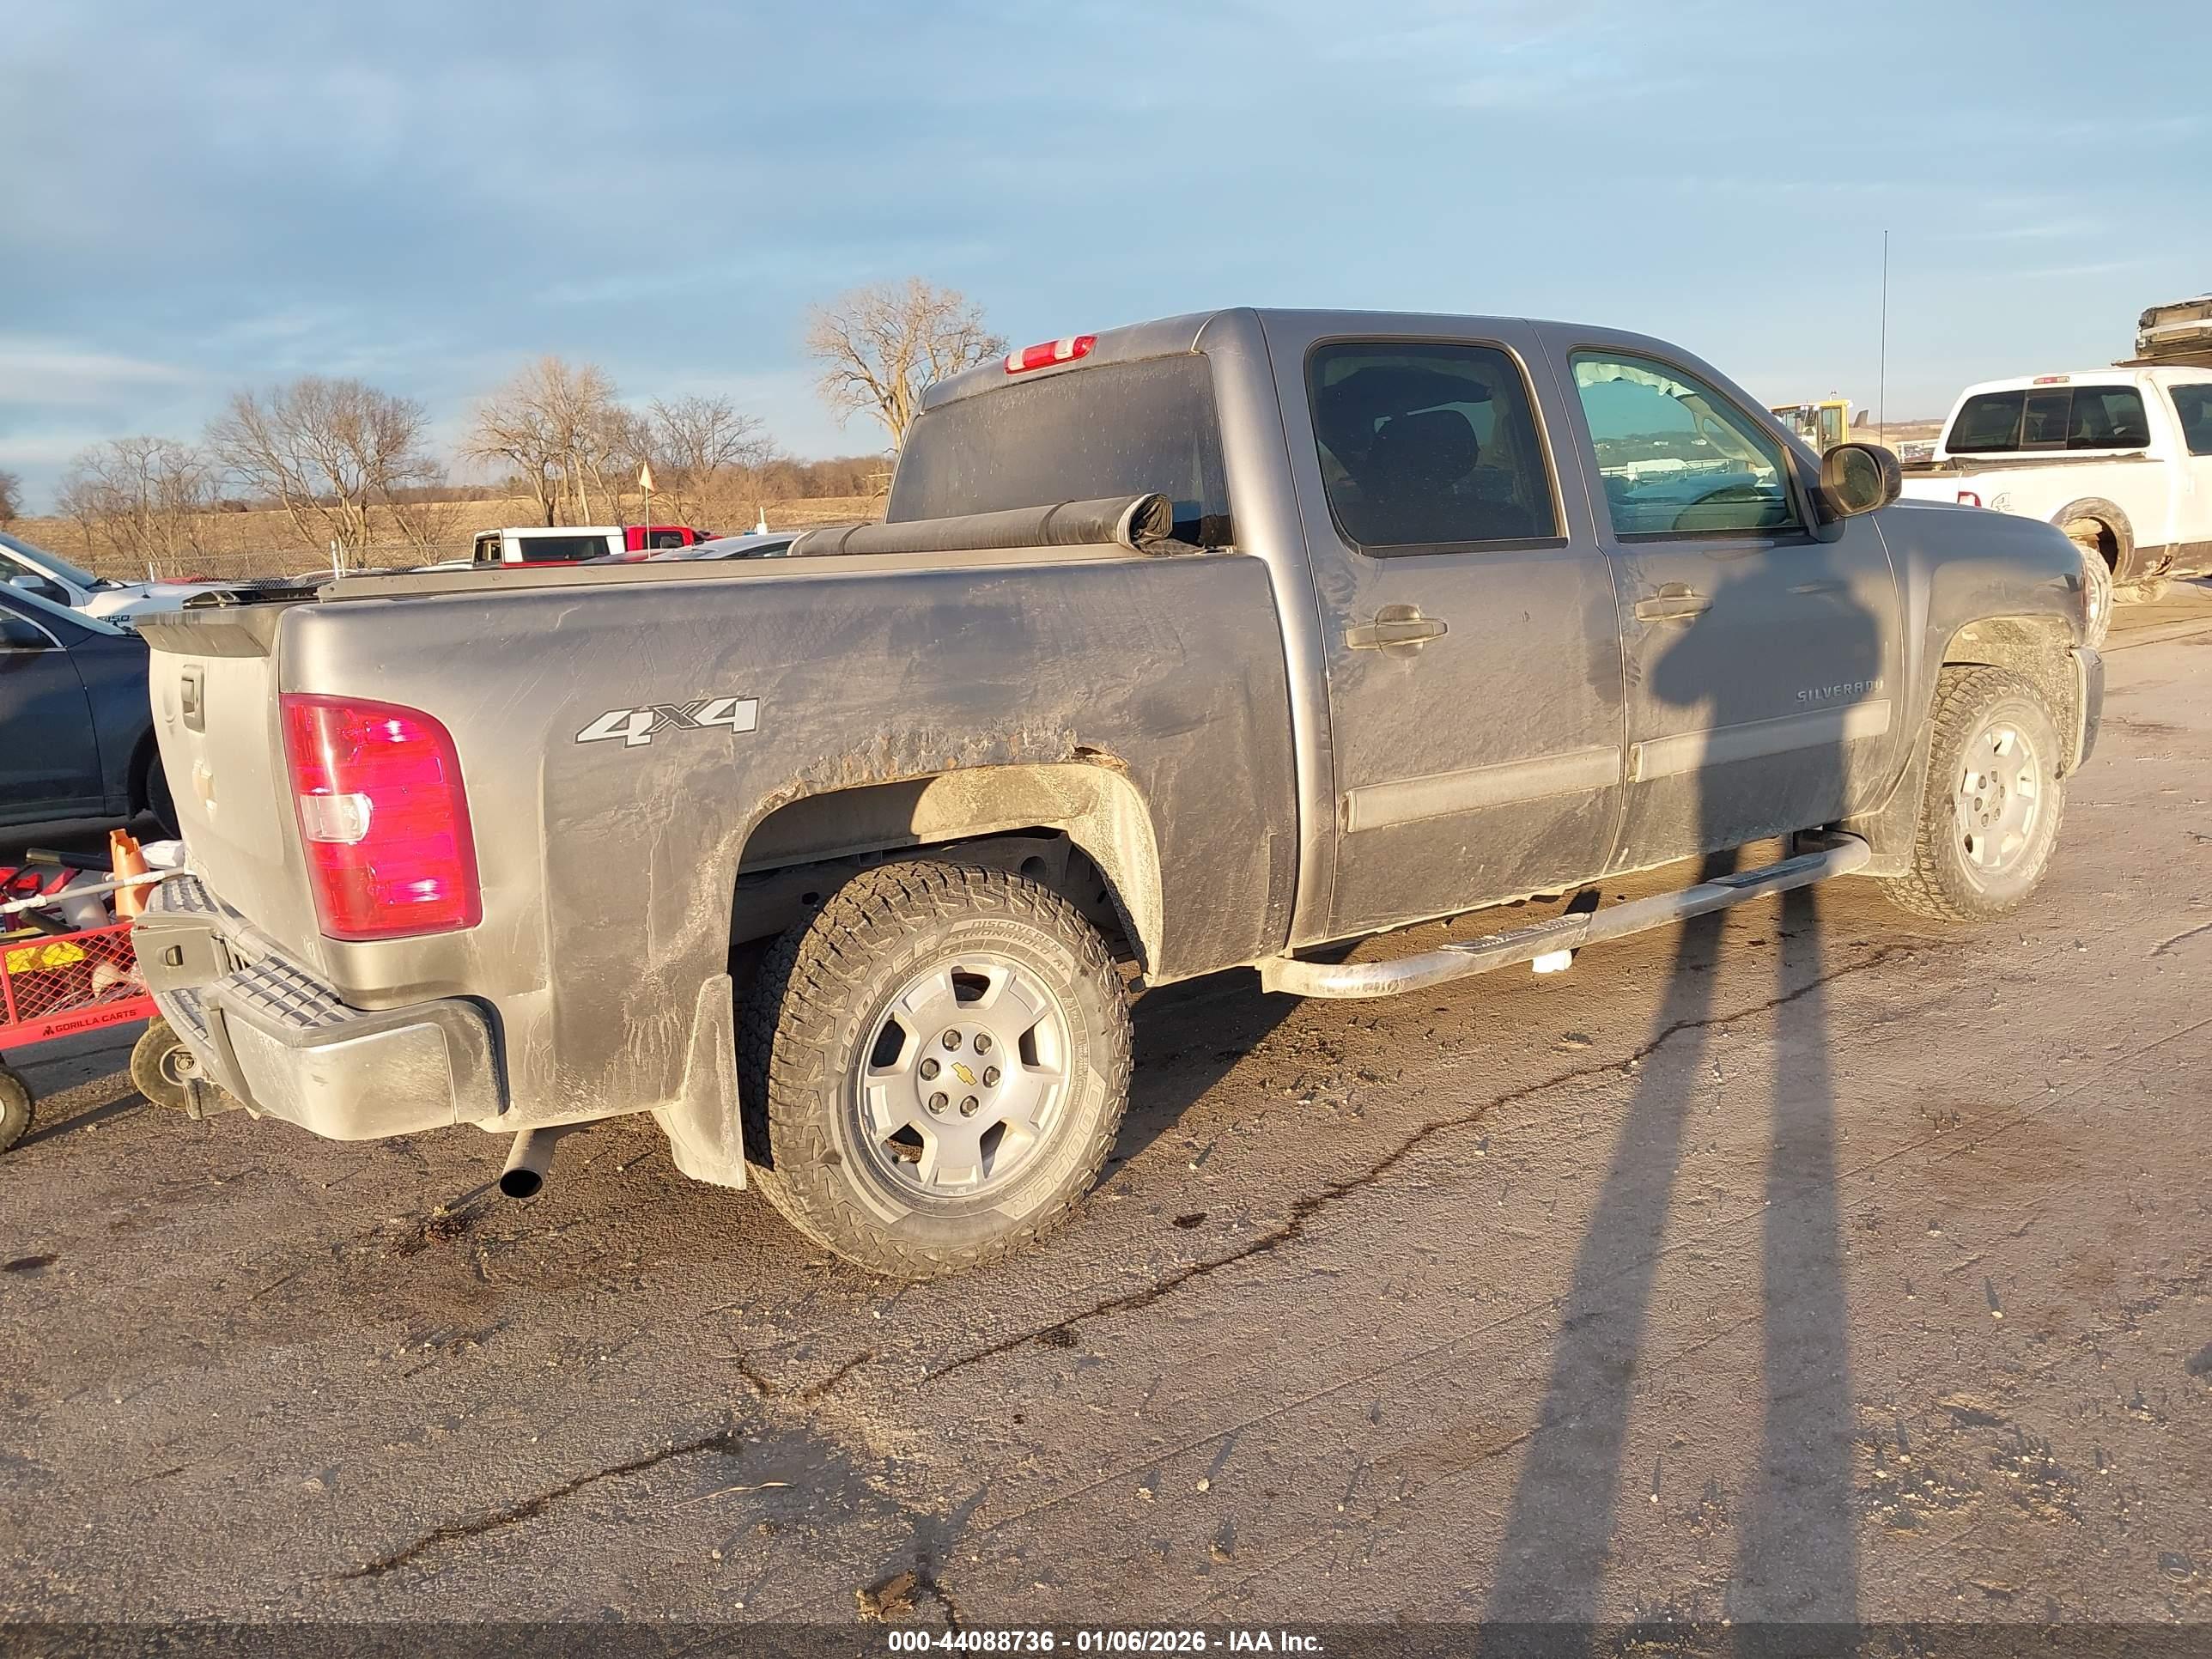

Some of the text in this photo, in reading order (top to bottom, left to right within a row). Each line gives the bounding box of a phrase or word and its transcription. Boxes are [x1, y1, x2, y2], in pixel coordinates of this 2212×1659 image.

[971, 920, 1062, 953] DISCOVERER
[1053, 957, 1071, 973] AT
[835, 933, 939, 1074] COOPER
[55, 1009, 137, 1032] GORILLA CARTS
[1012, 1082, 1104, 1218] COOPER
